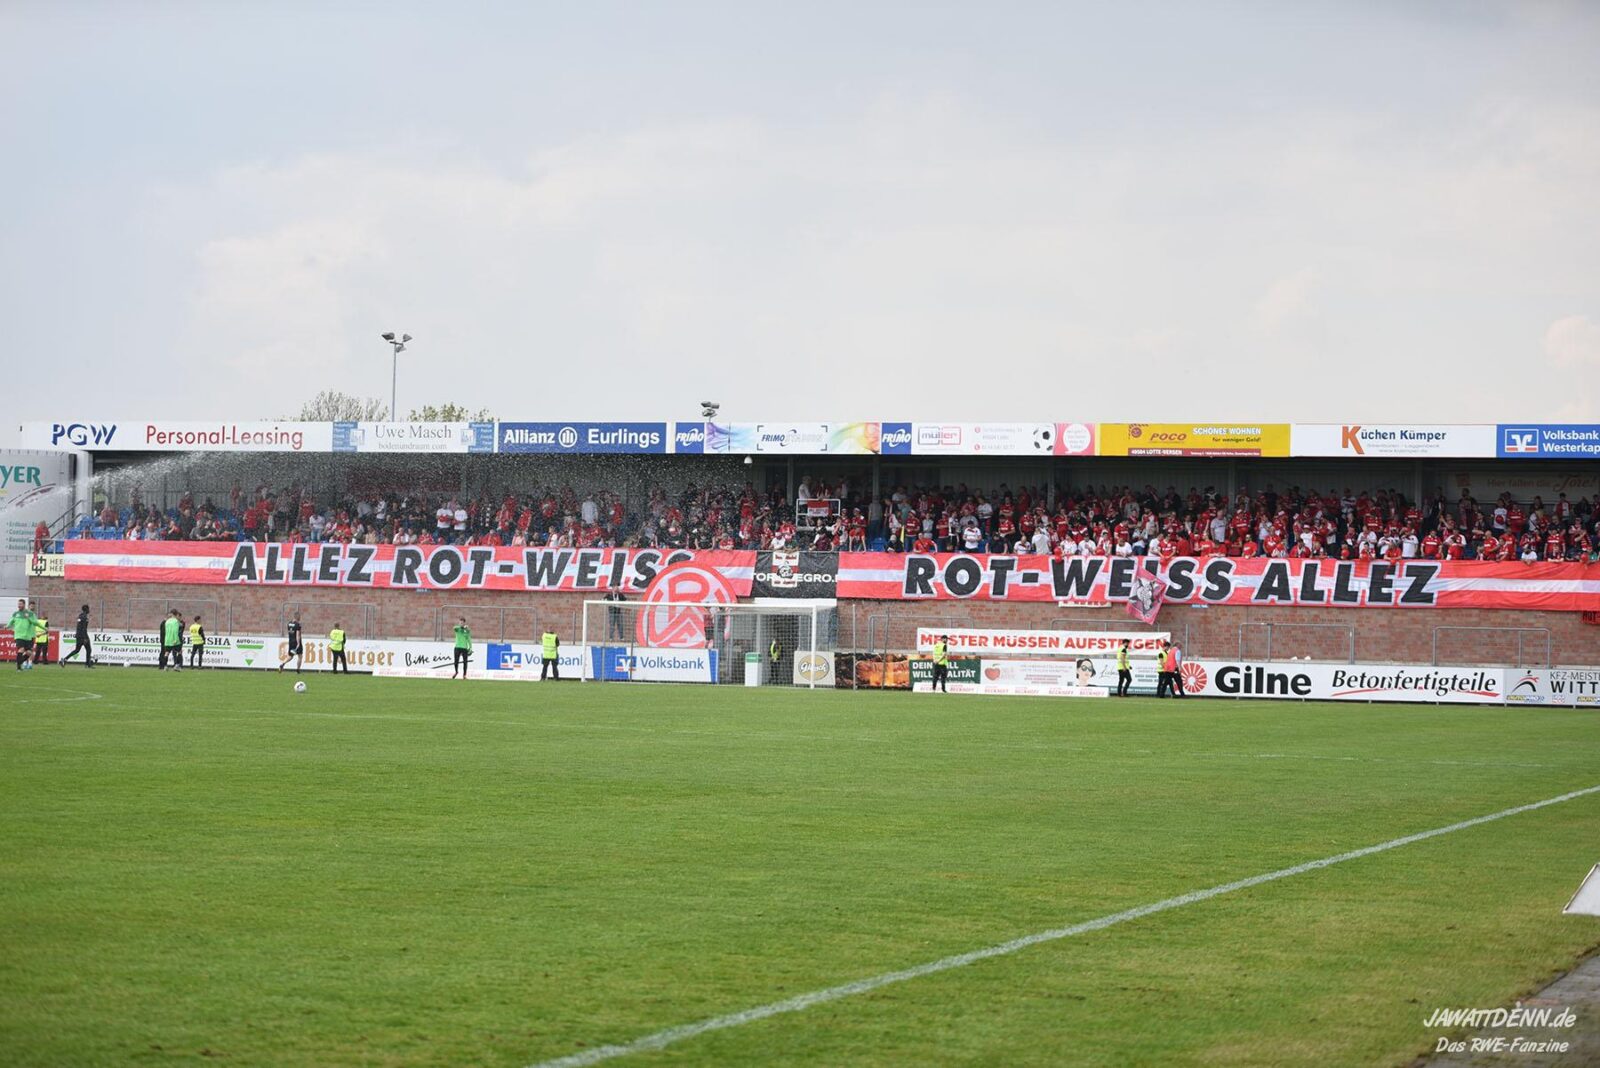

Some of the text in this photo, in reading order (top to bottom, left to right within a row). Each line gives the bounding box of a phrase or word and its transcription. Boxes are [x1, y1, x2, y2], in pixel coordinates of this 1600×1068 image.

[51, 423, 117, 446] PGW
[146, 425, 303, 450] Personal-Leasing
[375, 425, 405, 439] Uwe
[409, 424, 452, 439] Masch
[504, 428, 555, 444] Allianz
[588, 428, 660, 448] Eurlings
[676, 429, 704, 445] FRIMO
[761, 434, 786, 443] FRIMO
[882, 430, 912, 446] FRIMO
[1150, 432, 1187, 441] POCO
[1192, 427, 1262, 436] SCHÖNES WOHNEN
[1543, 430, 1600, 440] Volksbank
[1341, 425, 1447, 455] Küchen Kümper
[228, 544, 376, 585] ALLEZ
[1253, 561, 1441, 604] ALLEZ
[93, 634, 112, 643] Kfz
[920, 634, 1167, 650] MESTER MÜSSEN AUFSTGEN
[304, 641, 395, 667] Biturger
[405, 652, 430, 667] Bitte
[640, 656, 704, 669] Volksbank
[912, 662, 933, 670] DEIN
[912, 669, 976, 679] WILL ALITÄT
[1214, 665, 1312, 695] Gilne
[1332, 670, 1496, 697] Betonfertigteile
